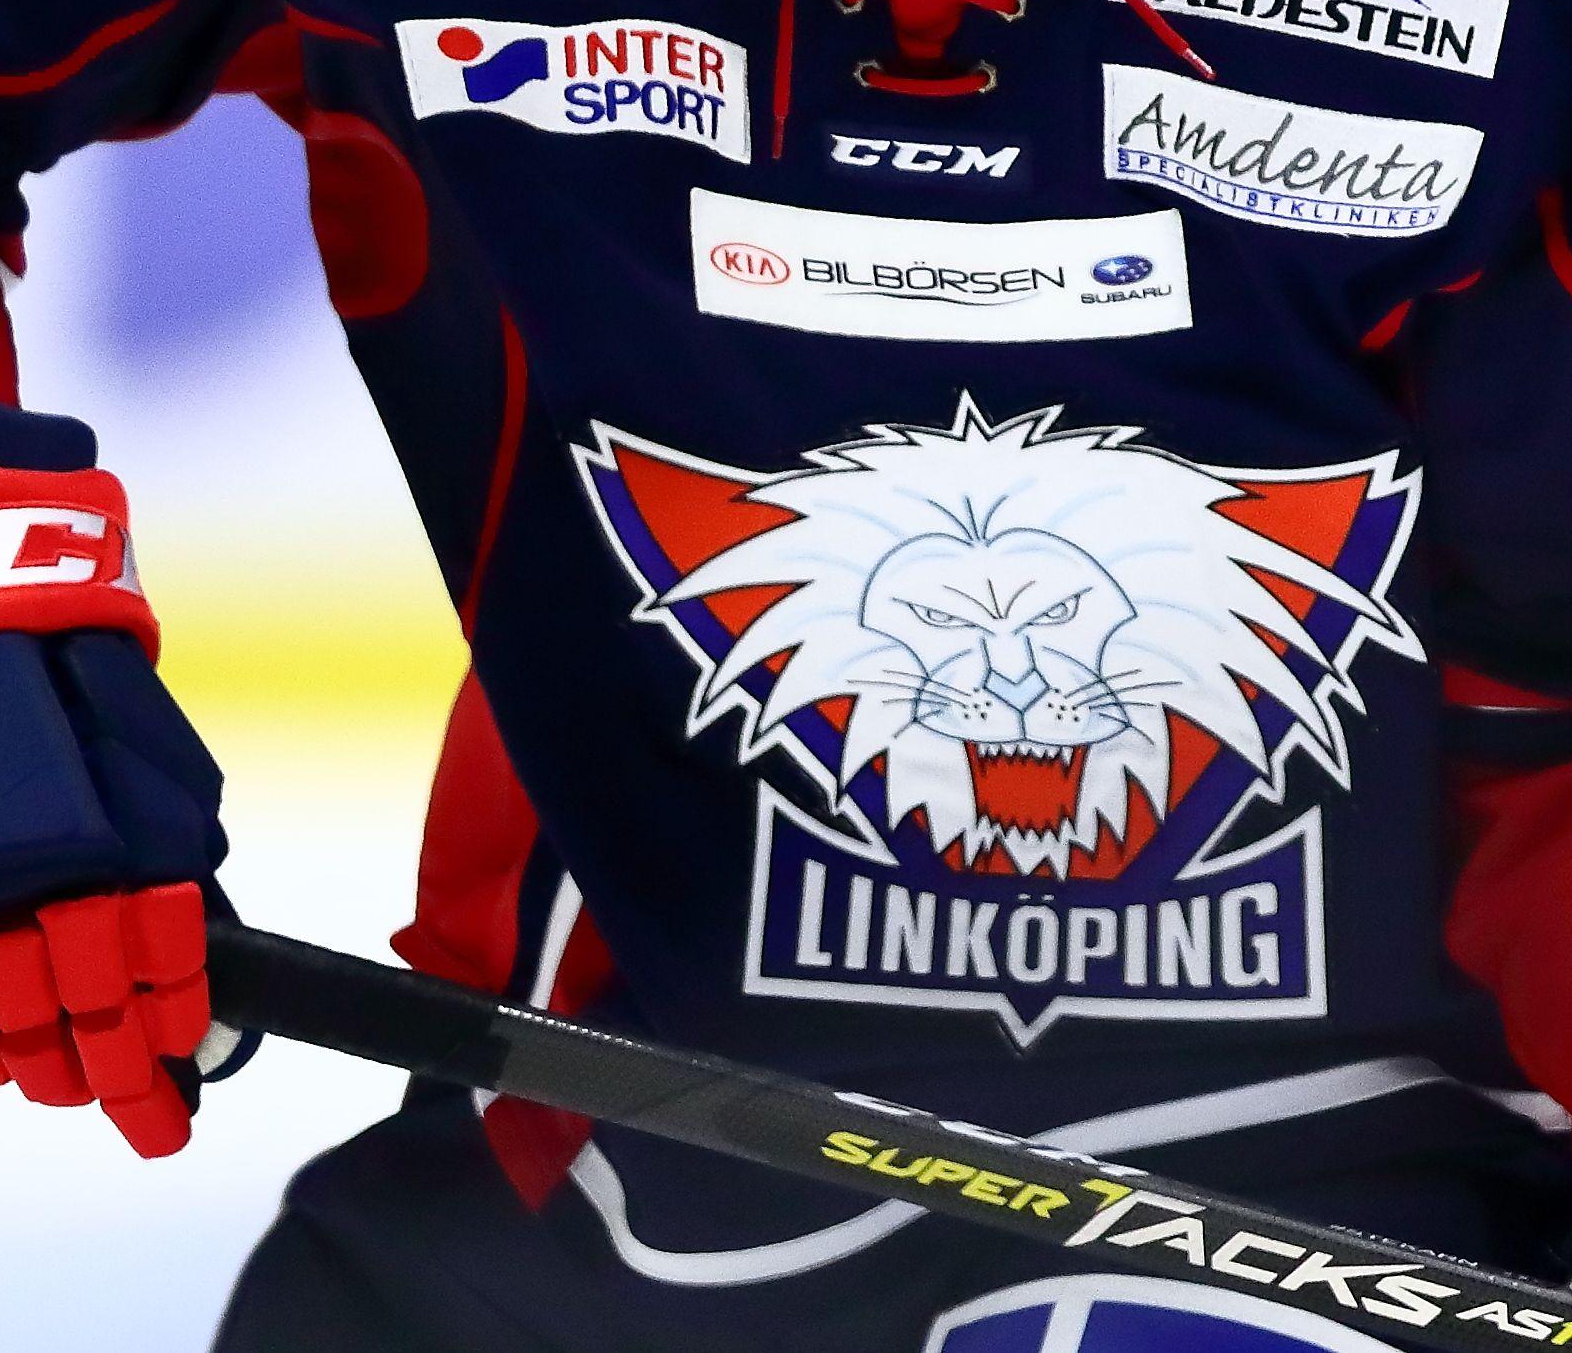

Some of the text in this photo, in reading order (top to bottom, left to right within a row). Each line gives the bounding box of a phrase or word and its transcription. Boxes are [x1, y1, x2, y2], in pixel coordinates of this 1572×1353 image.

[563, 28, 725, 93] INTER
[564, 80, 725, 141] SPORT
[830, 134, 1021, 179] CCM
[1116, 92, 1460, 201] Amdenta
[724, 250, 1173, 304] KIA BILBÖRSEN SUBARU
[795, 858, 1281, 989] LINKÖPING
[820, 1130, 1071, 1219] SUPER
[1063, 1178, 1462, 1329] TACKS
